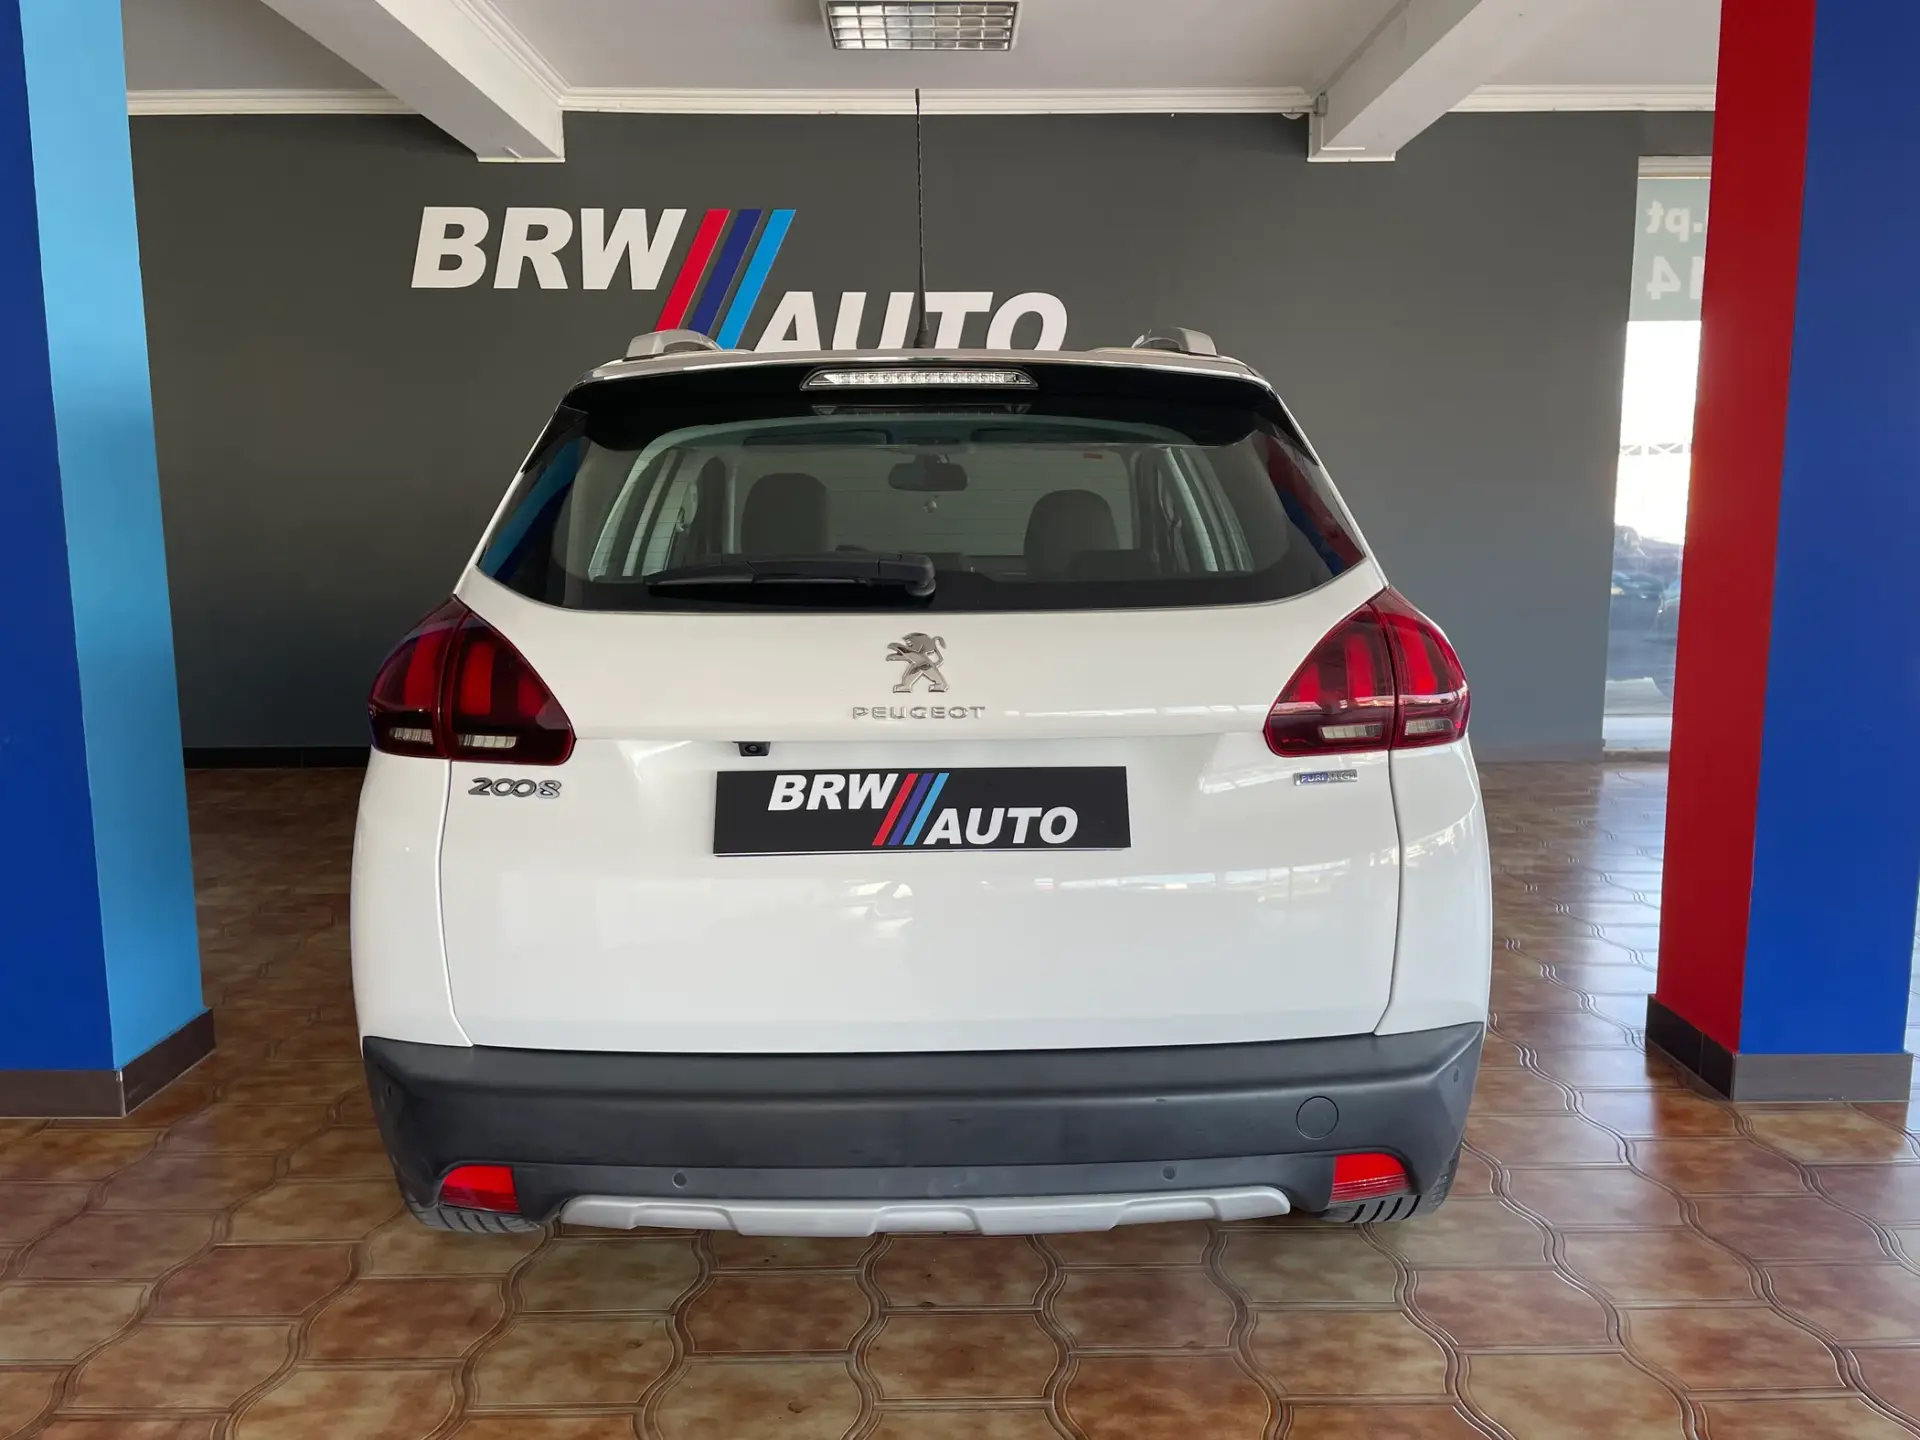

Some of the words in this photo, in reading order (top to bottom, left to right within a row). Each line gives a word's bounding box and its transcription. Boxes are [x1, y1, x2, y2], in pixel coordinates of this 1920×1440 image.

[411, 206, 687, 290] BRW
[753, 291, 1068, 352] AUTO
[852, 706, 986, 719] PEUGEOT
[467, 777, 562, 799] 2008
[767, 773, 899, 811] BRW
[922, 806, 1079, 845] AUTO
